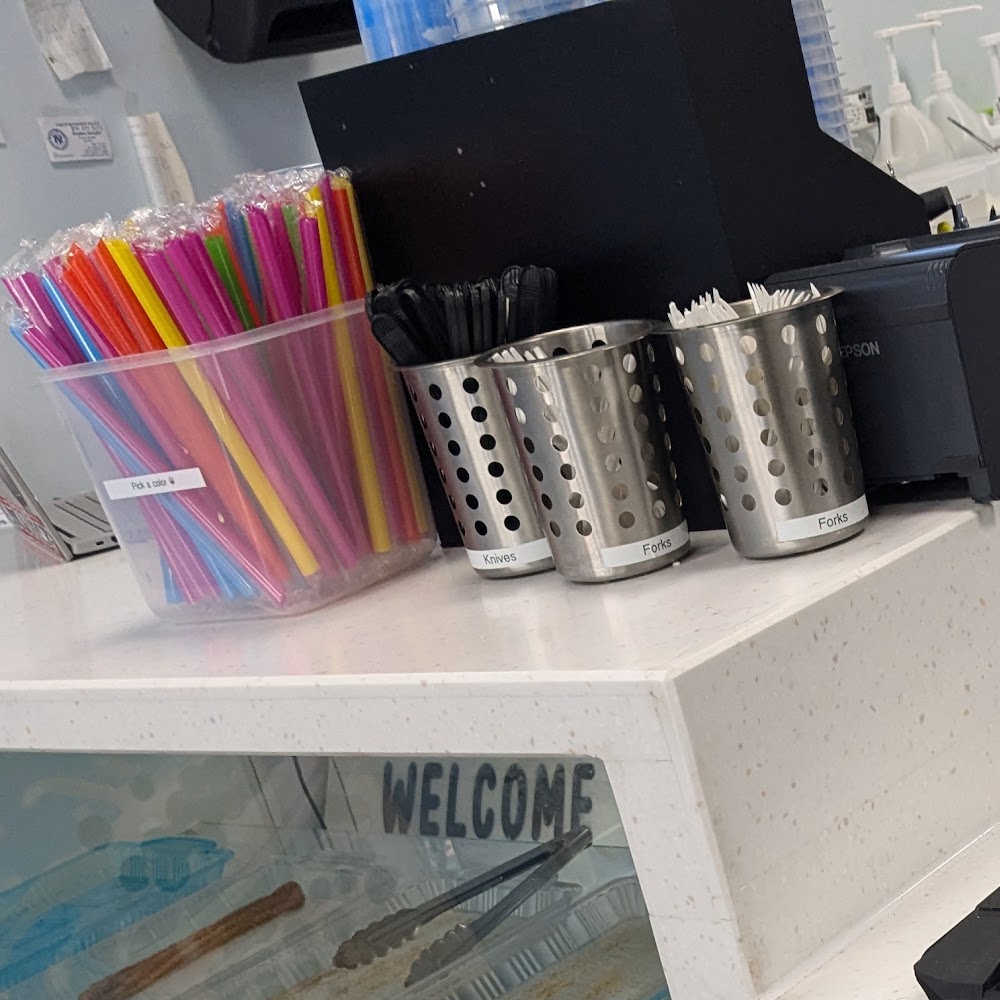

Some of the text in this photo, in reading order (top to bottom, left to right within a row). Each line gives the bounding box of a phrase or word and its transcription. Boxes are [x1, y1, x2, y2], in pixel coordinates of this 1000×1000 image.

[839, 341, 881, 358] EPSON
[131, 481, 146, 491] Pick
[152, 478, 168, 488] color
[817, 511, 850, 531] Forks
[642, 537, 673, 556] Forks
[482, 551, 518, 567] Knives
[382, 760, 597, 842] WELCOME
